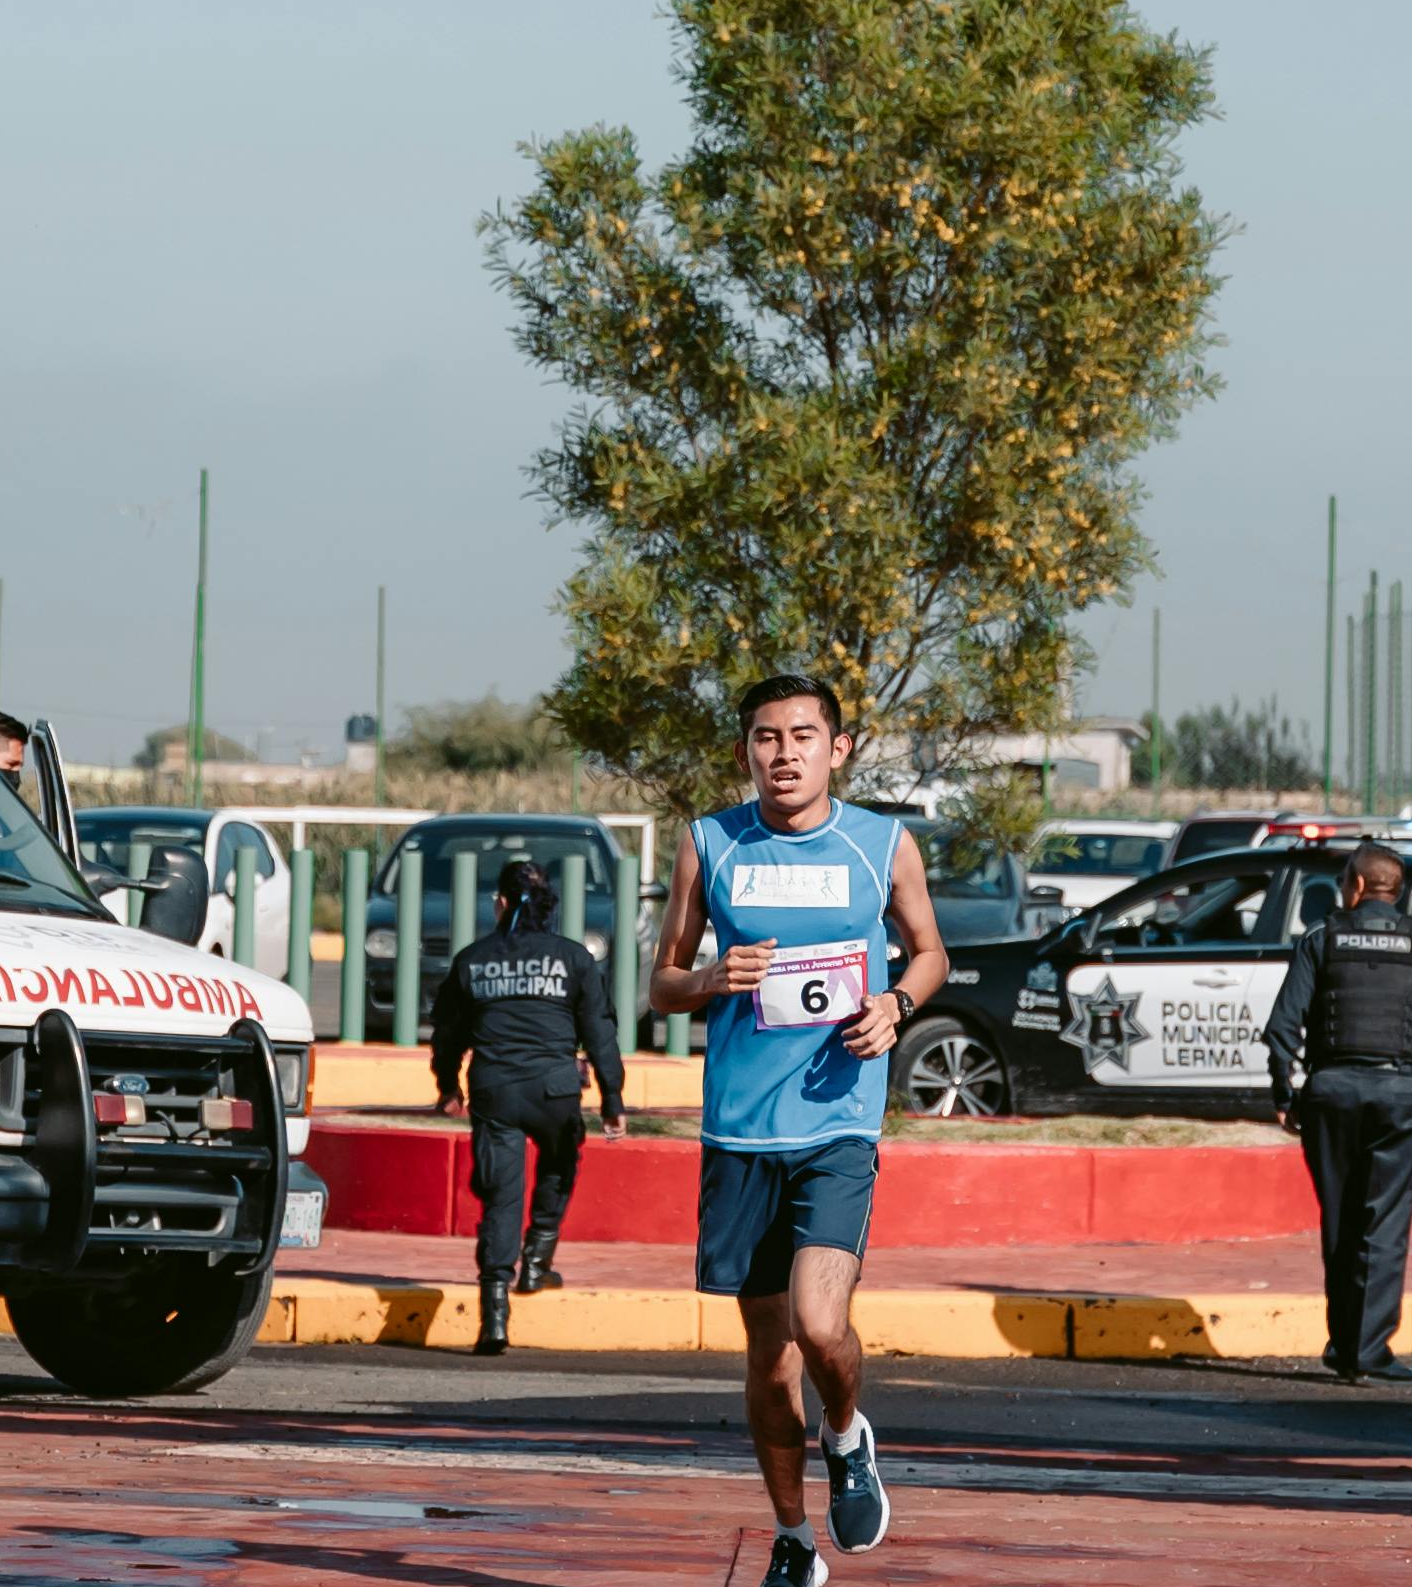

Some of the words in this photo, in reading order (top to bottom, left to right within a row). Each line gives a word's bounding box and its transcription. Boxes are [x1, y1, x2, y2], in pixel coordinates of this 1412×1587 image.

[1335, 934, 1407, 949] POLICIA
[469, 955, 568, 979] POLICÍA
[471, 976, 567, 999] MUNICIPAL
[801, 979, 829, 1015] 6
[1162, 1001, 1253, 1023] POLICIA
[1162, 1025, 1266, 1046] MUNICIPA
[1163, 1047, 1245, 1069] LERMA
